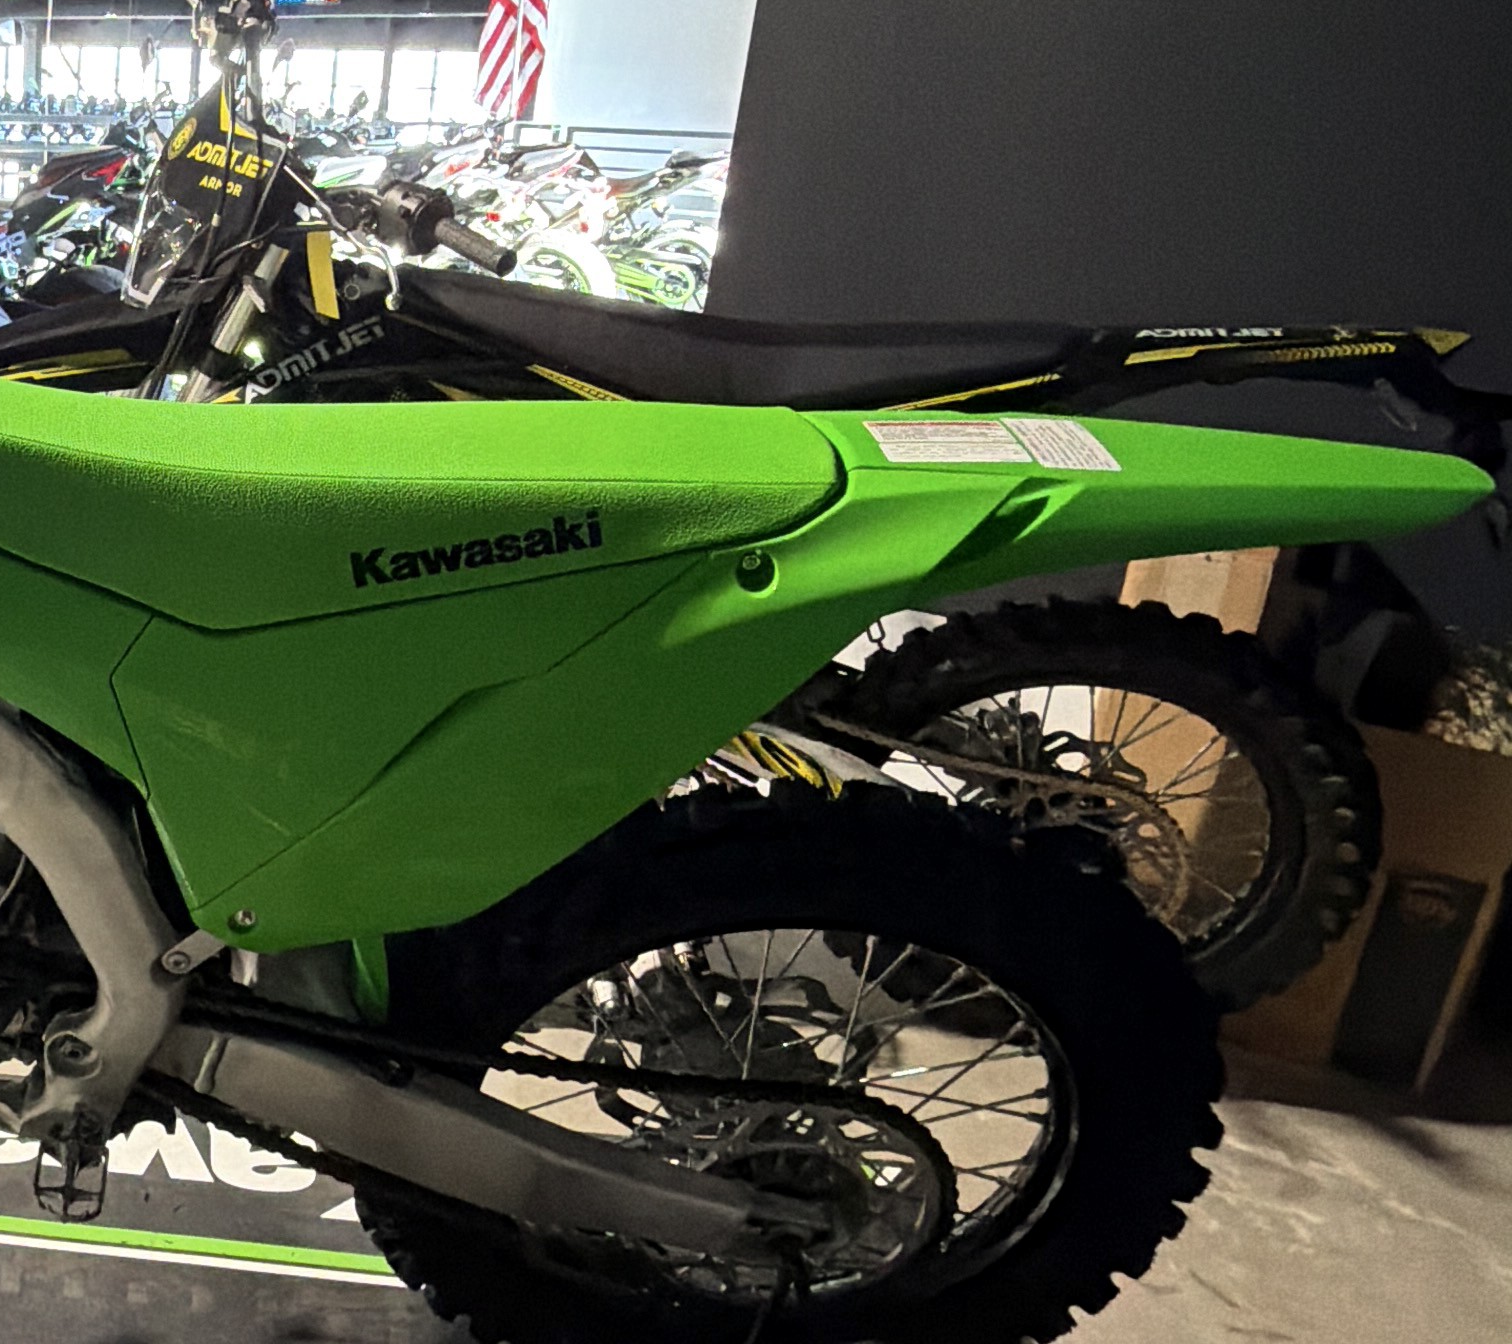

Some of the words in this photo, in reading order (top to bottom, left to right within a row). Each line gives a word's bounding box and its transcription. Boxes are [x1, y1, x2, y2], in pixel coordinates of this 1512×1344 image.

[234, 154, 274, 179] JET
[245, 339, 330, 404] ADMIT
[336, 315, 385, 355] JET
[349, 510, 603, 588] Kawasaki
